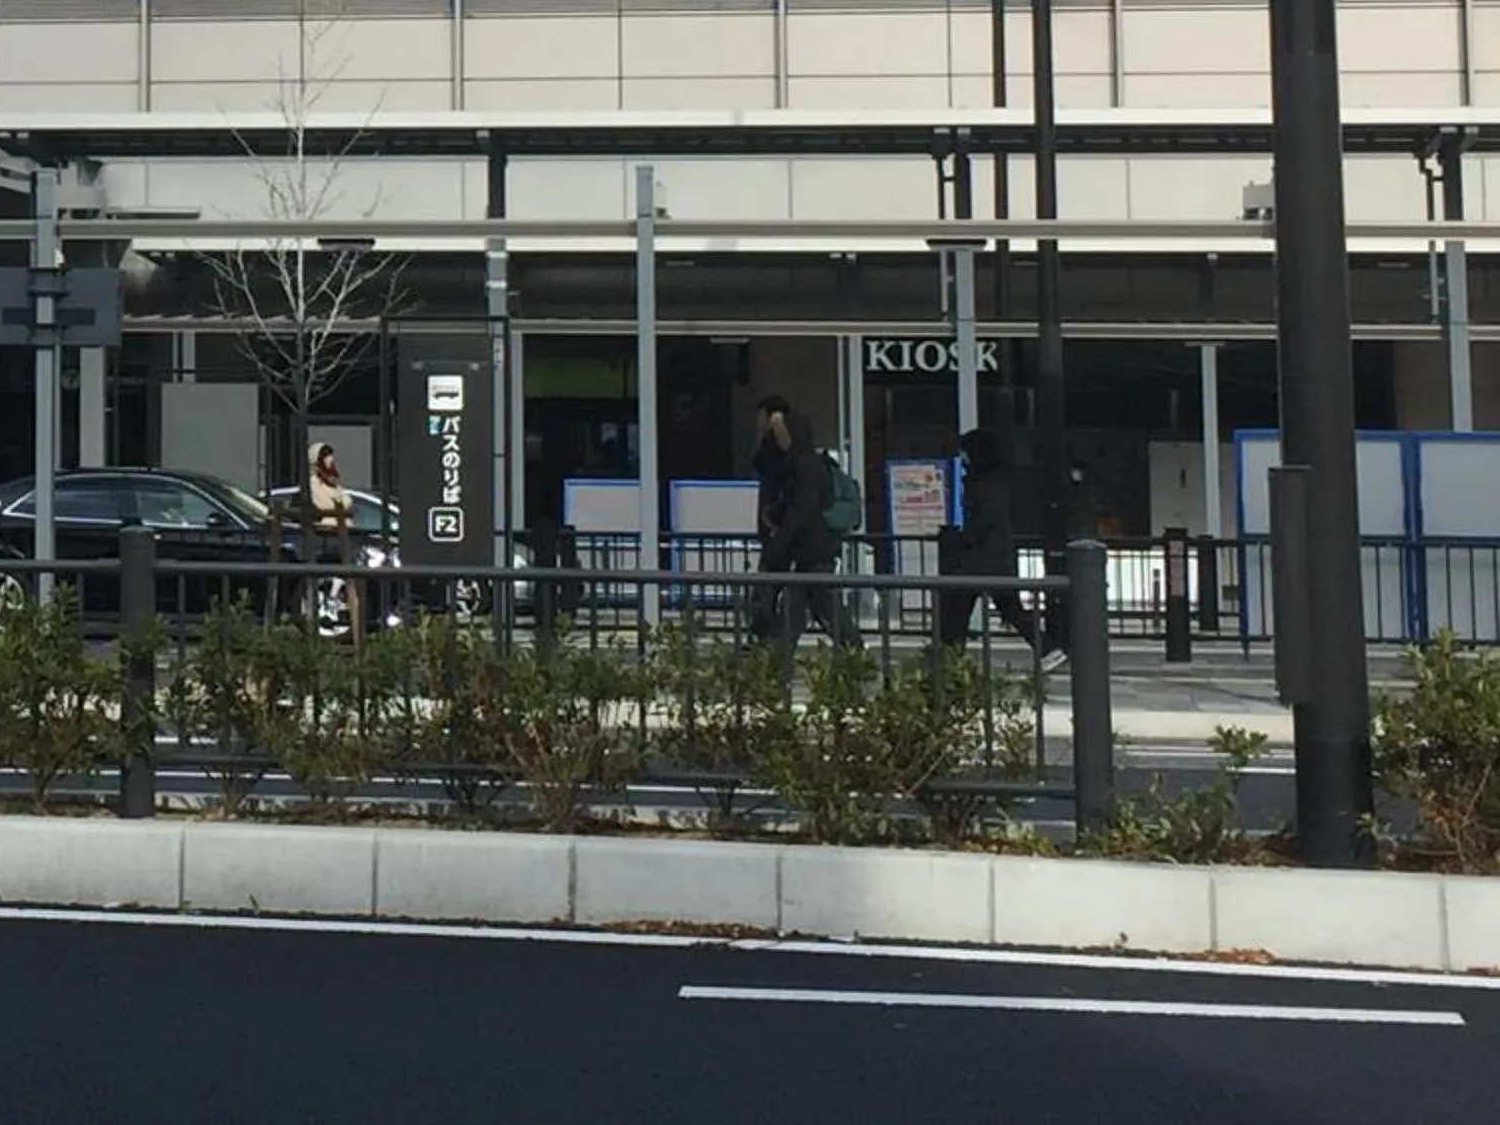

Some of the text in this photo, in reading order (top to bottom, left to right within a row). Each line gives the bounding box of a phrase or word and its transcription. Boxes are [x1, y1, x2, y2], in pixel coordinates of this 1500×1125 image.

[442, 415, 462, 505] バスのりば
[434, 515, 458, 533] F2
